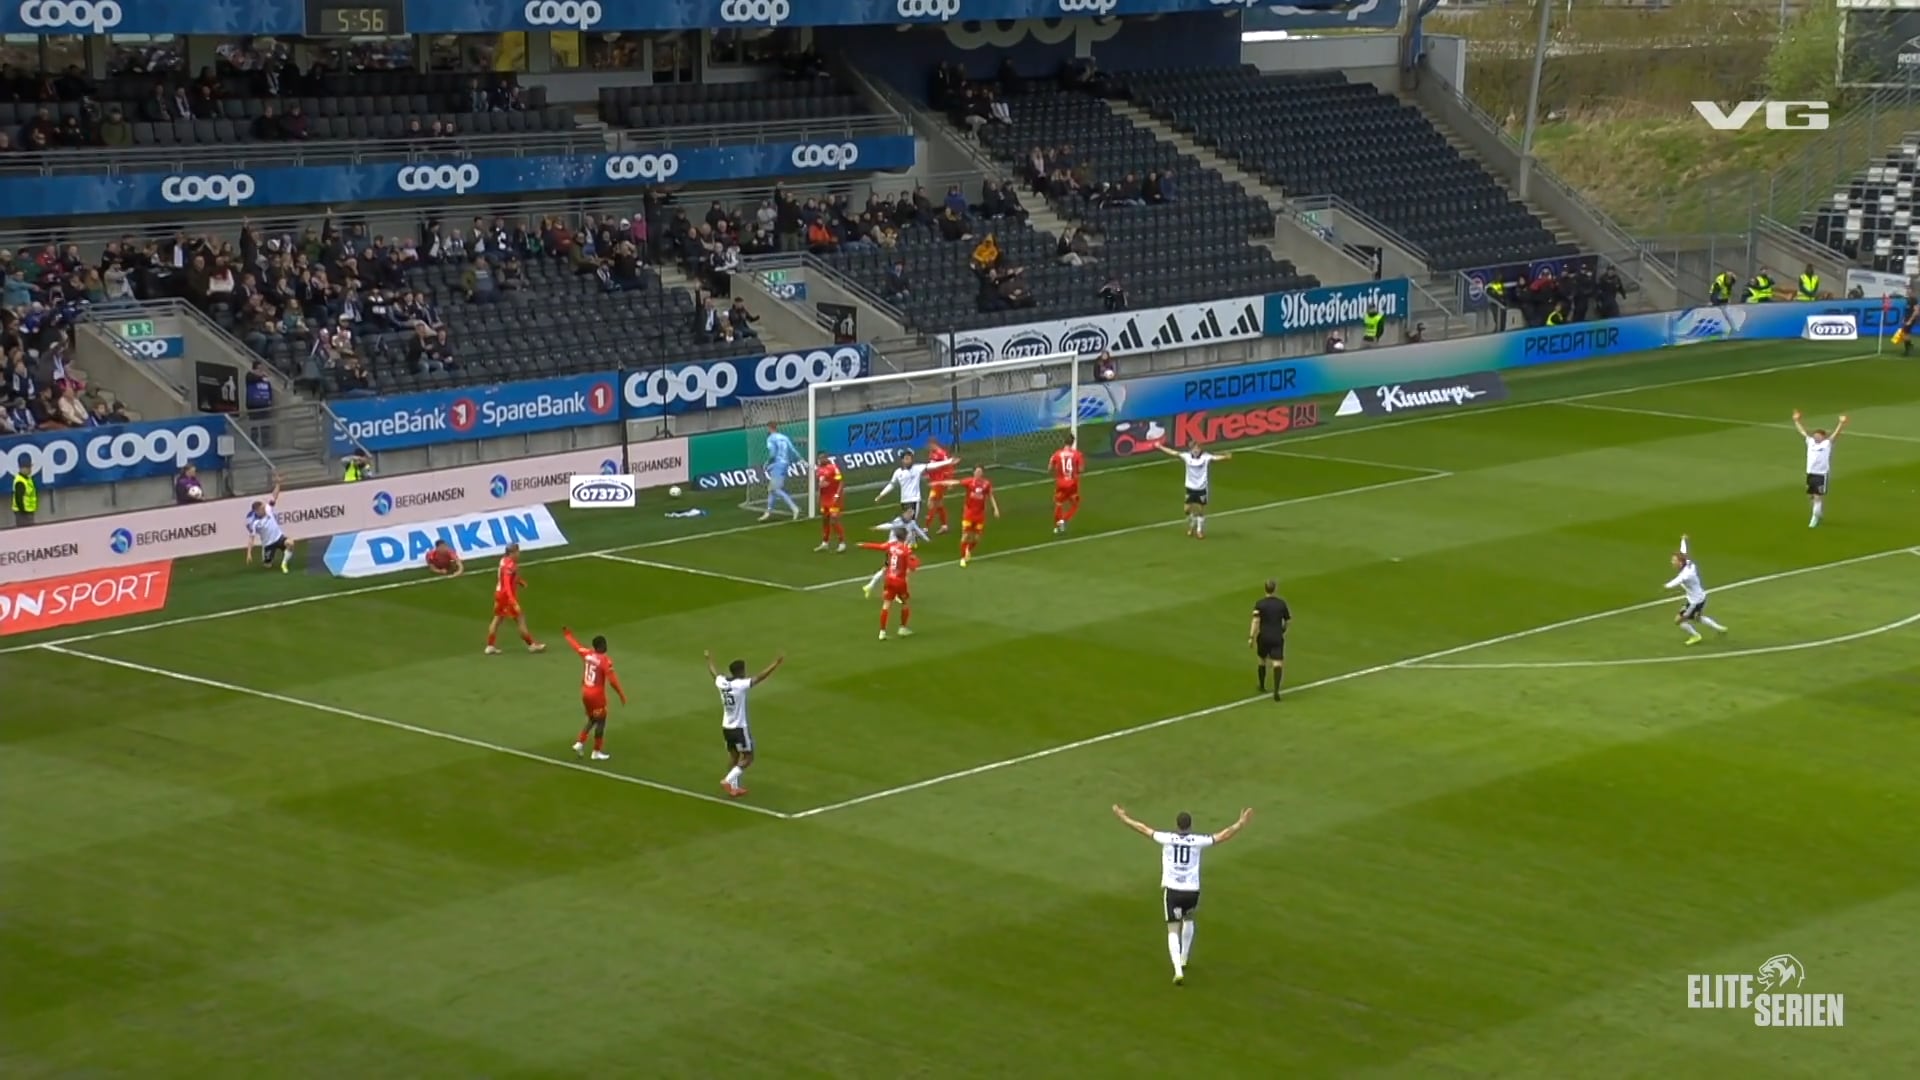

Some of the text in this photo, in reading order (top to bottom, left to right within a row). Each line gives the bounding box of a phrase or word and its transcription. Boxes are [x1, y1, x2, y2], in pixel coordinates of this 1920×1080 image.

[20, 0, 122, 32] coop
[337, 9, 384, 32] 5:56
[525, 0, 602, 30] coop
[720, 0, 790, 26] coop
[605, 153, 678, 182] coop
[791, 142, 858, 170] coop
[162, 174, 255, 206] coop
[397, 163, 479, 194] coop
[1066, 337, 1102, 351] 07373
[1524, 327, 1619, 357] PREDATOR
[1815, 325, 1851, 335] 07373
[755, 347, 861, 391] coop
[624, 361, 738, 408] coop
[1184, 368, 1297, 402] PREDATOR
[1376, 384, 1486, 412] Kinnarps
[482, 391, 586, 427] SpareBank
[847, 408, 981, 447] PREDATOR
[1175, 404, 1290, 448] Kress
[85, 425, 211, 467] coop
[846, 448, 894, 468] SPORT
[395, 486, 465, 509] BERGHANSEN
[580, 487, 625, 501] 07373
[136, 522, 217, 546] BERGHANSEN
[366, 513, 541, 565] DAIKIN
[49, 571, 161, 614] SPORT
[1173, 844, 1191, 865] 10
